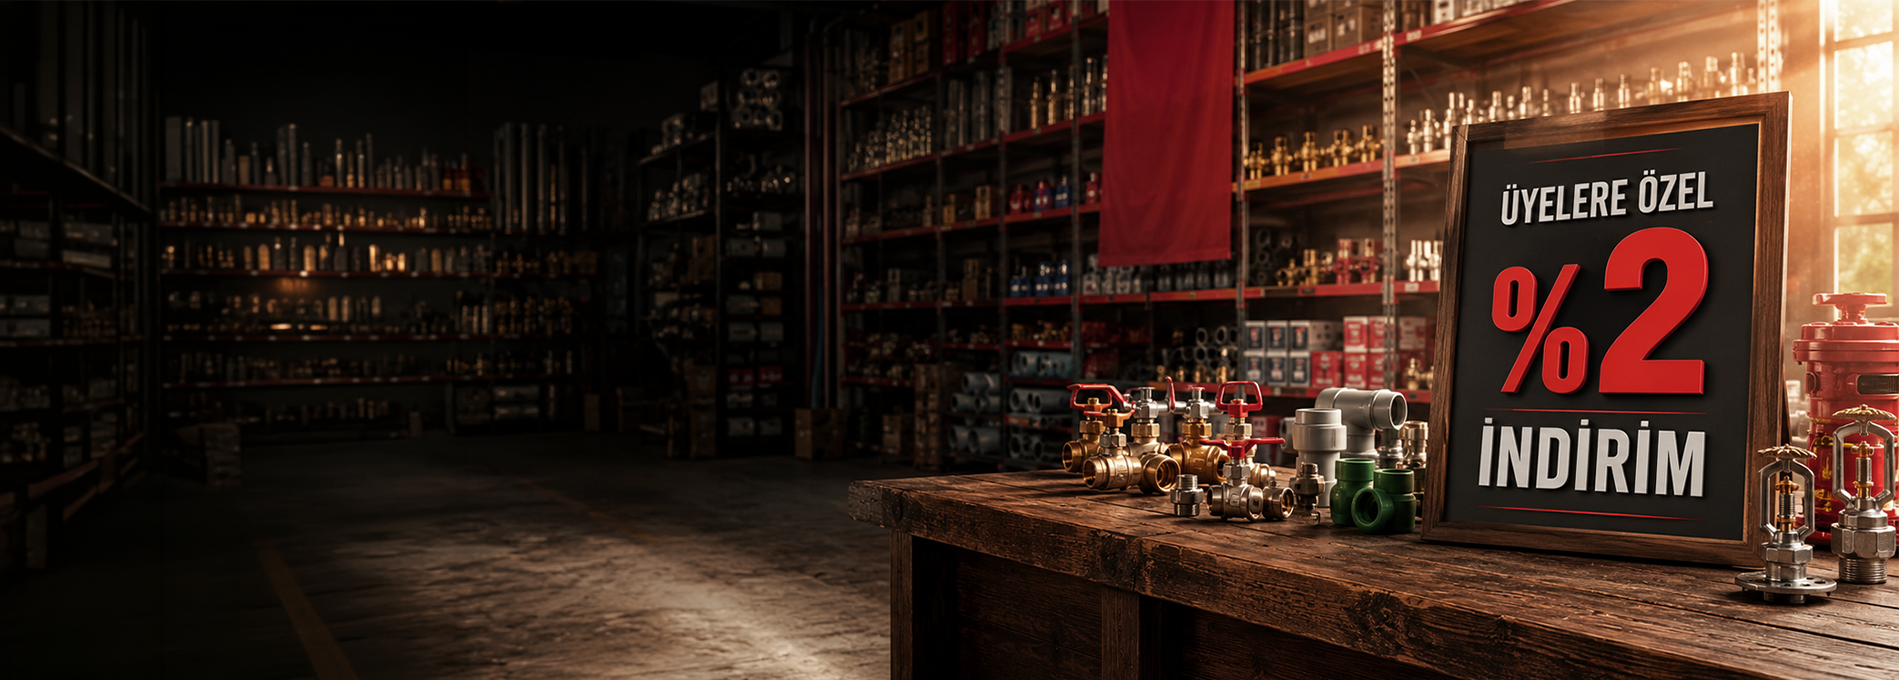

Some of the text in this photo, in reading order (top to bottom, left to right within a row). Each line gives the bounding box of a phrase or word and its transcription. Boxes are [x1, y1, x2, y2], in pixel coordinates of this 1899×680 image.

[1501, 170, 1713, 226] ÜYELERE ÖZEL
[1492, 227, 1709, 394] %2
[1478, 417, 1706, 497] İNDİRİM
